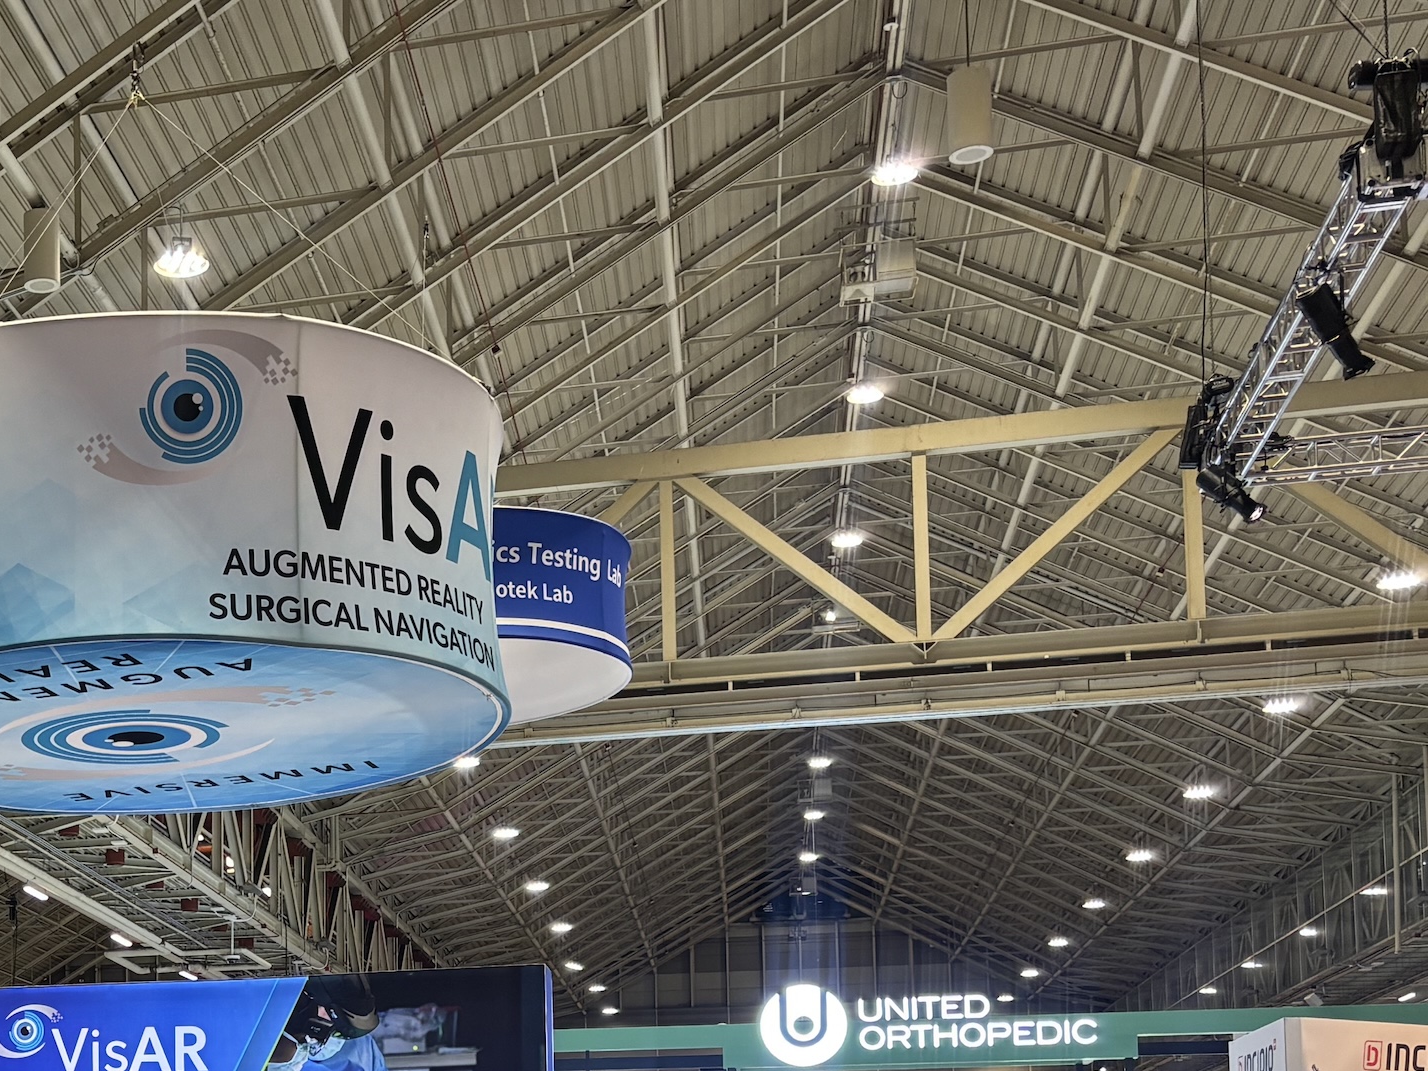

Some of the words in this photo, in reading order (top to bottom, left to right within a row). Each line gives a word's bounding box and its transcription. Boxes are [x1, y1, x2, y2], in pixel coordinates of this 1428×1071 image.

[223, 548, 412, 597] AUGMENTED
[417, 575, 484, 625] REALITY
[527, 542, 601, 581] Testing
[607, 559, 622, 588] Lab
[543, 583, 574, 604] Lab
[209, 592, 369, 632] SURGICAL
[373, 607, 495, 672] NAVIGATION
[63, 760, 380, 803] IMMERSIVE
[857, 994, 991, 1022] UNITED
[858, 1018, 1098, 1051] ORTHOPEDIC
